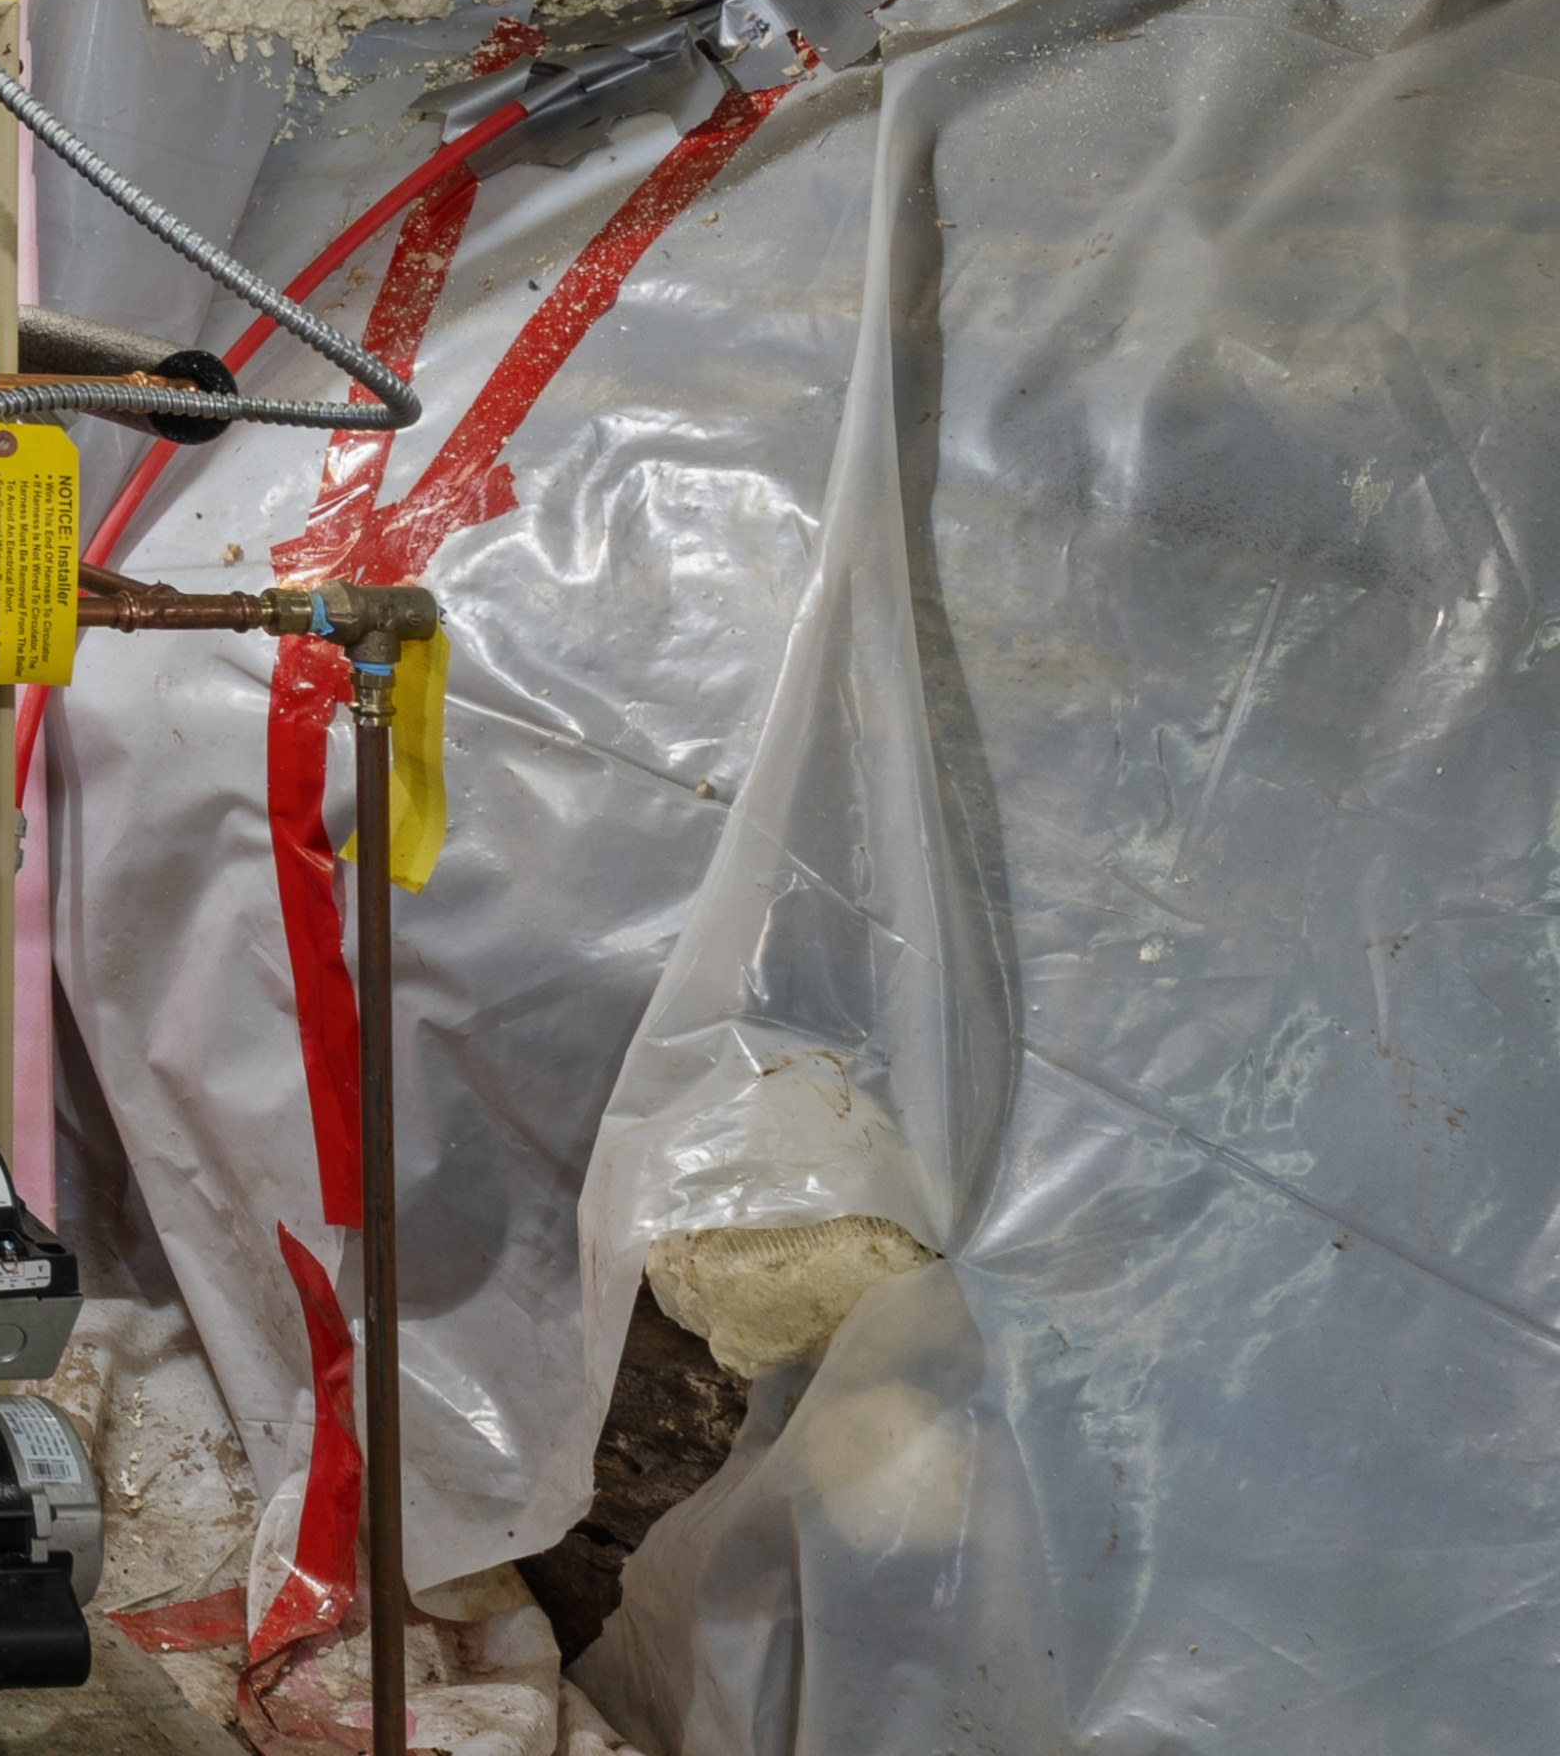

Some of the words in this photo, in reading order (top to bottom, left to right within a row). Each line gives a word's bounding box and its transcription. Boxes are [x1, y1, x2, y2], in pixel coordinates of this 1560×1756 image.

[7, 480, 15, 491] To
[45, 482, 53, 503] Wire
[7, 494, 15, 521] Avoid
[20, 481, 28, 520] Harness
[33, 490, 41, 529] Harness
[58, 475, 73, 540] NOTICE:
[45, 507, 53, 526] This
[7, 524, 14, 537] An
[19, 523, 27, 546] Must
[45, 530, 53, 548] End
[6, 541, 14, 584] Electrical
[19, 550, 27, 562] Be
[45, 552, 53, 564] Of
[18, 565, 27, 608] Removed
[32, 563, 40, 591] Wired
[43, 566, 52, 604] Harness
[58, 545, 71, 606] Installer
[5, 587, 14, 615] Short.
[32, 593, 40, 605] To
[18, 611, 27, 635] From
[43, 608, 52, 618] To
[30, 608, 40, 653] Circulator,
[42, 621, 52, 663] Circulator
[17, 638, 26, 653] The
[15, 656, 25, 677] Boiler
[29, 655, 38, 669] The
